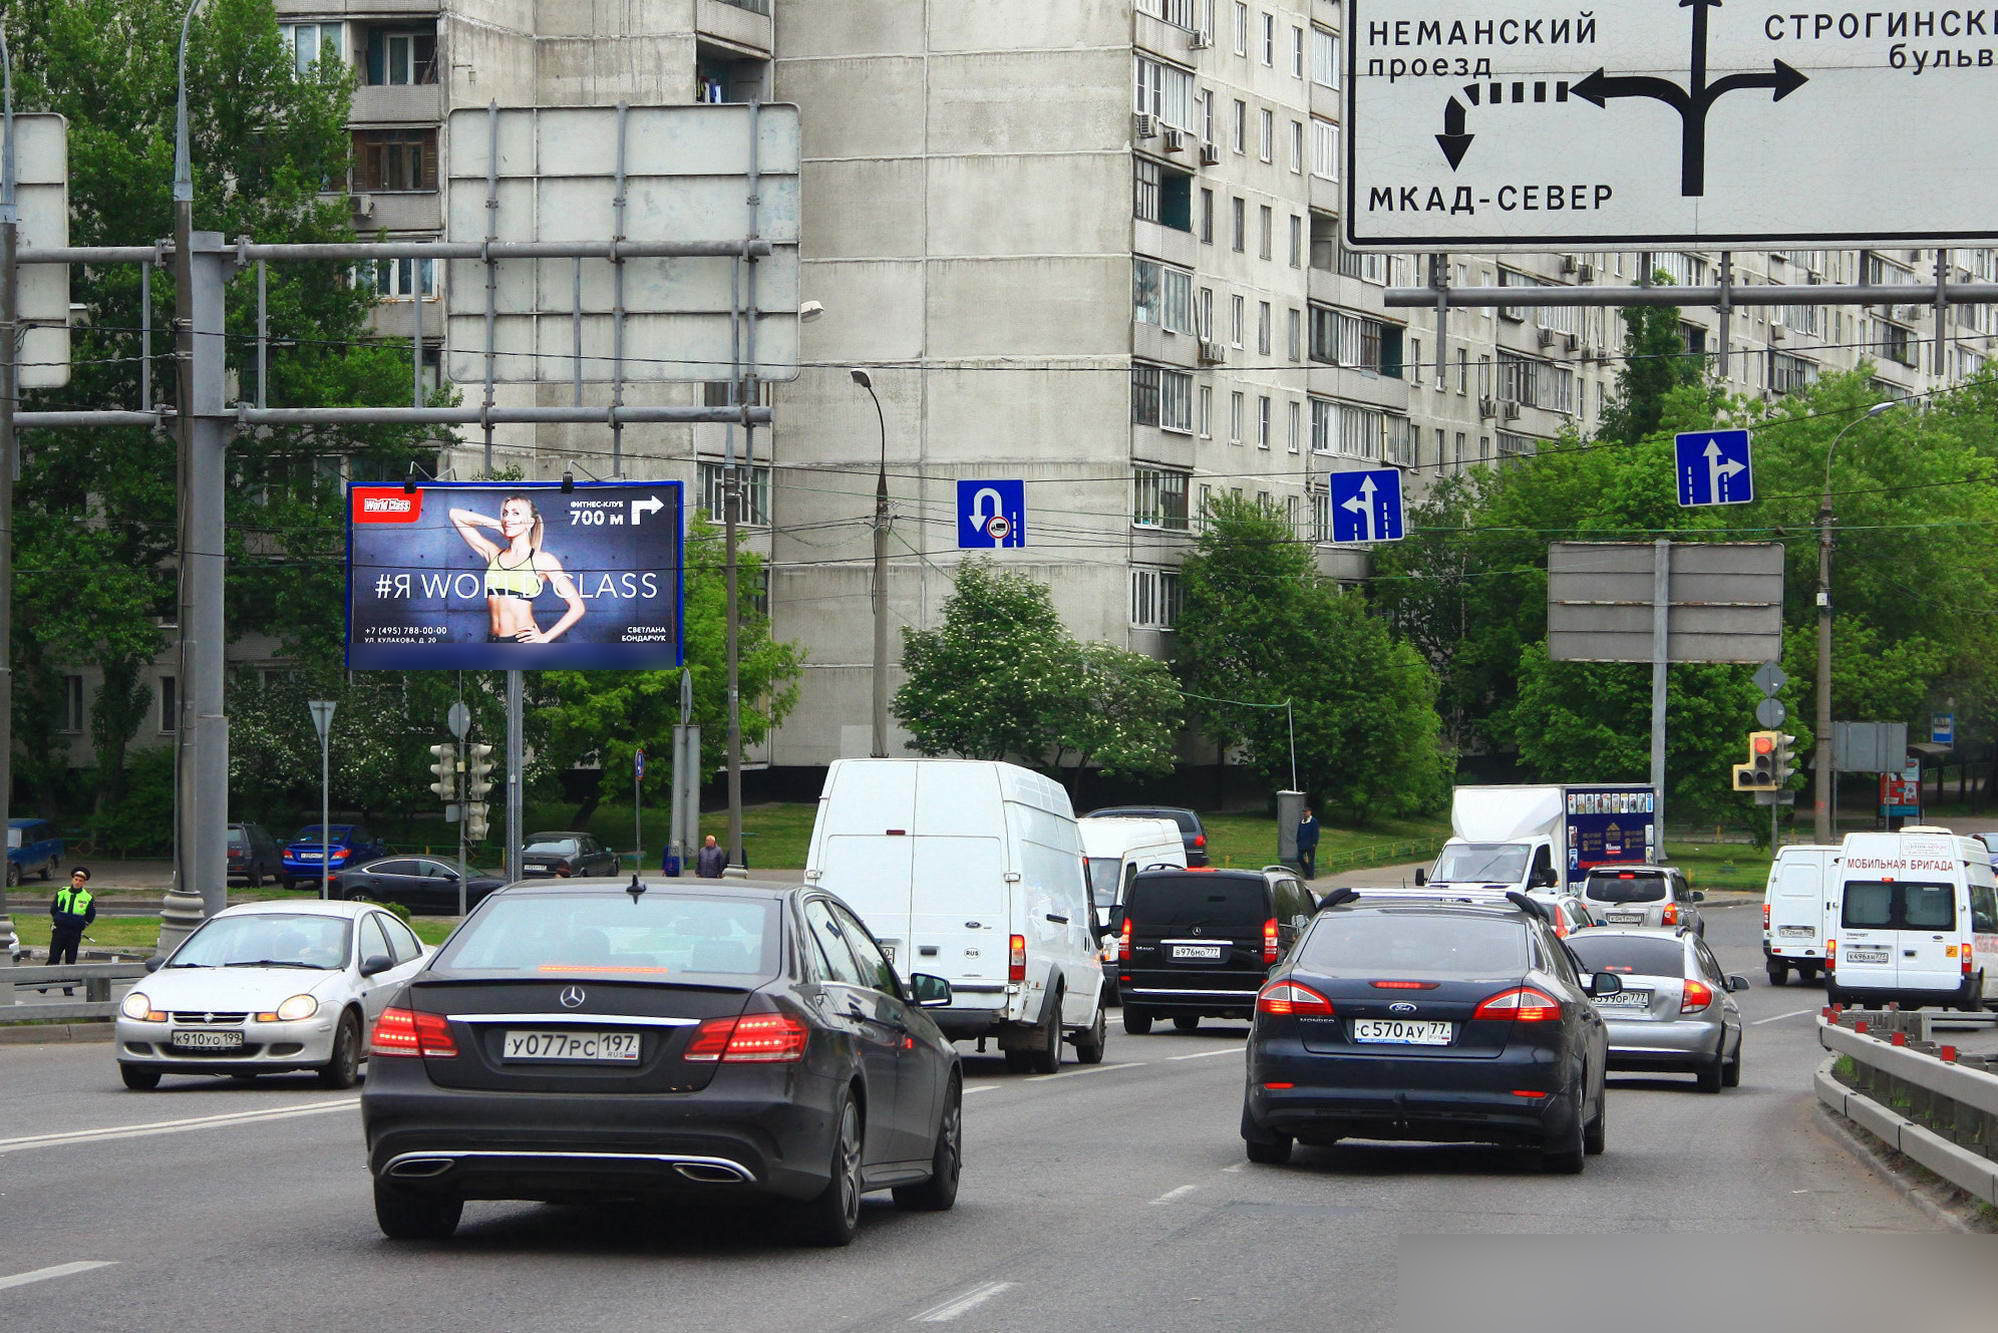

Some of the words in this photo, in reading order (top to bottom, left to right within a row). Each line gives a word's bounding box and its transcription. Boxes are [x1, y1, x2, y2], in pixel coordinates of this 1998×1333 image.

[1369, 10, 1596, 46] НЕМАНСКИЙ
[1764, 9, 1998, 41] СТРОГИНСК
[1368, 57, 1492, 84] проезд
[1368, 184, 1613, 215] МКАД-СЕВЕР
[364, 499, 388, 511] World
[388, 499, 410, 511] Class
[570, 510, 605, 526] 700
[375, 573, 411, 599] #Я
[420, 573, 544, 599] WORLD
[553, 573, 658, 599] CLASS
[365, 626, 376, 635] +7
[378, 626, 401, 636] (495)
[403, 626, 447, 635] 788-00-00
[1847, 858, 1907, 870] МОБИЛЬНАЯ
[1910, 859, 1954, 871] БРИГАДА
